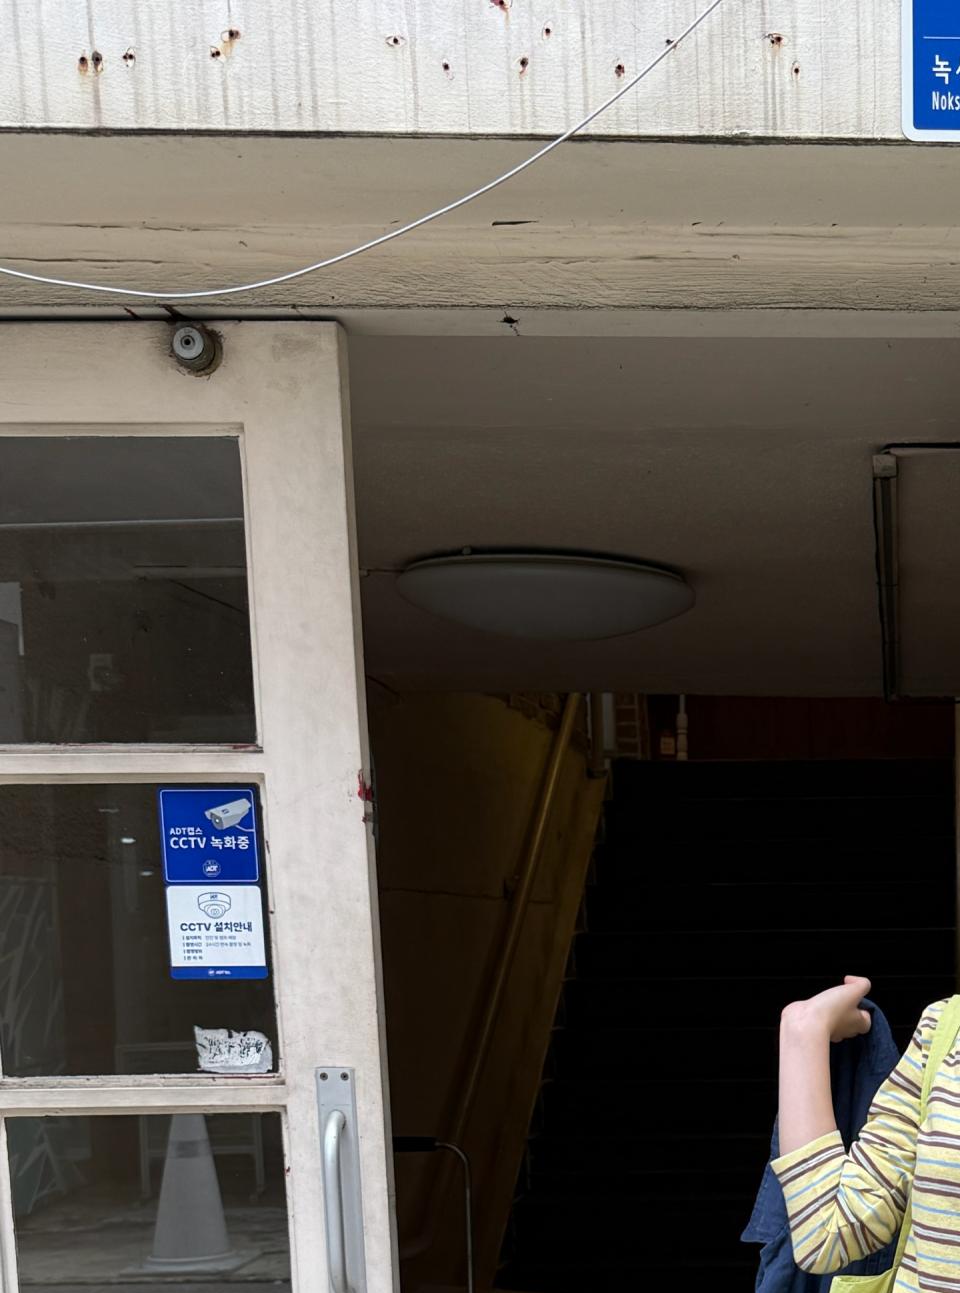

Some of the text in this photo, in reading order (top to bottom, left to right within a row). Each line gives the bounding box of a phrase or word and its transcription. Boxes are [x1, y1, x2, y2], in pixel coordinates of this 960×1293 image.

[169, 827, 203, 836] ADT캡스
[169, 836, 250, 850] CCTV 녹화중
[180, 921, 253, 933] CCTV 설치안내
